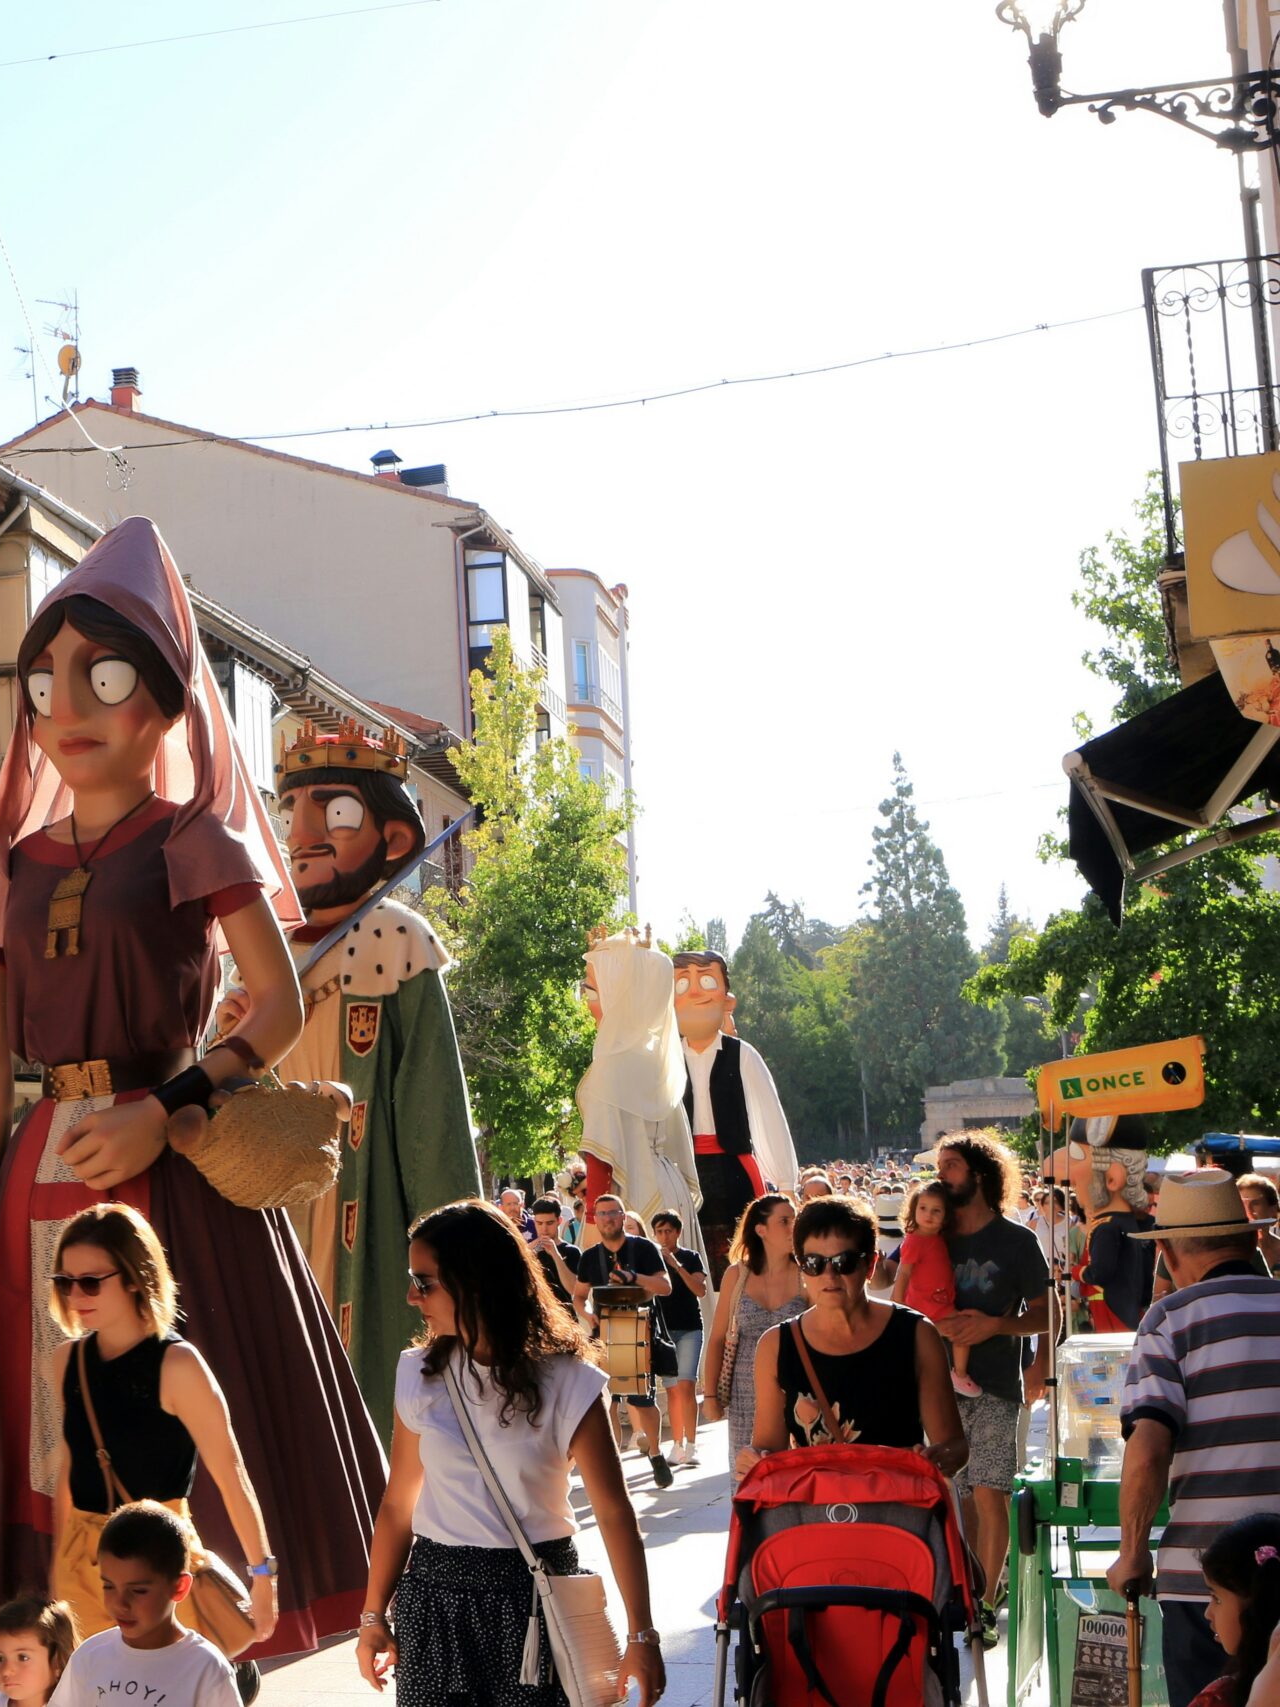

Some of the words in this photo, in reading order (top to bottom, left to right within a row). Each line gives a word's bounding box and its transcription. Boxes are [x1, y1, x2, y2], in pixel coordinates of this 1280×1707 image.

[1086, 1071, 1146, 1092] ONCE
[1081, 1618, 1128, 1639] 100000
[97, 1680, 167, 1707] AHOY!
